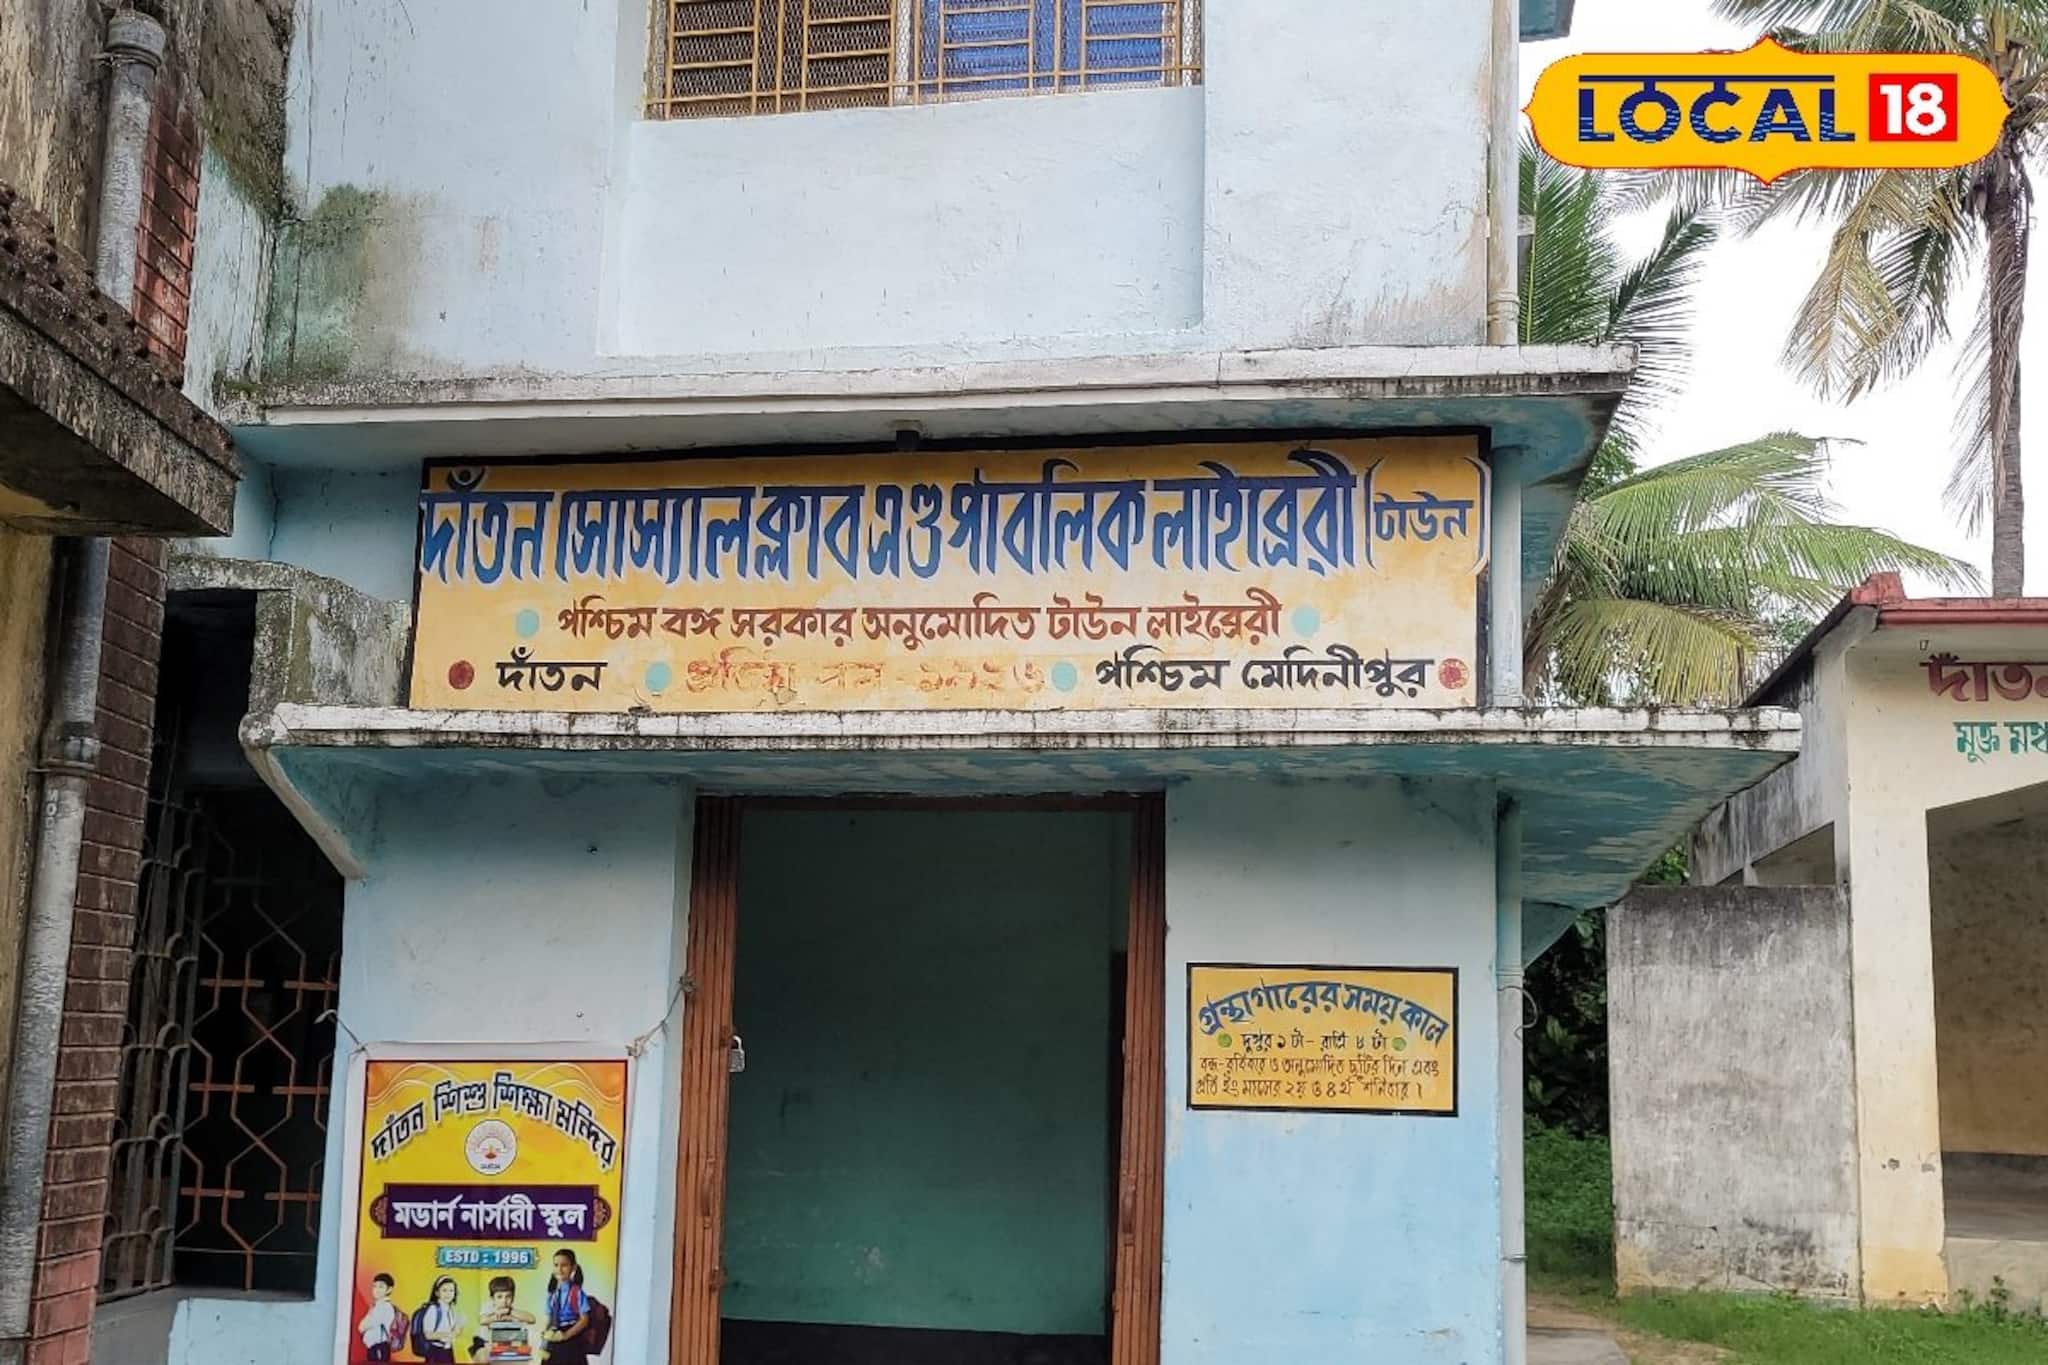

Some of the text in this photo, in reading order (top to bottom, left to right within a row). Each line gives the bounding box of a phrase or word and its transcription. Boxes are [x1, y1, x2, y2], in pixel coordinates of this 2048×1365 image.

[420, 467, 554, 584] দাঁতন
[948, 459, 1146, 576] পাবলিক
[558, 595, 657, 640] পশ্চিম
[730, 607, 857, 647] সরকার
[861, 591, 1041, 650] অনুমোদিত
[1046, 591, 1142, 640] টাউন
[496, 645, 608, 691] দাঁতন
[1095, 645, 1231, 692] পশ্চিম
[1242, 644, 1435, 697] মেদিনীপুর
[1920, 652, 2048, 702] দাঁত
[445, 1249, 480, 1264] ESTD
[494, 1250, 529, 1264] 1996
